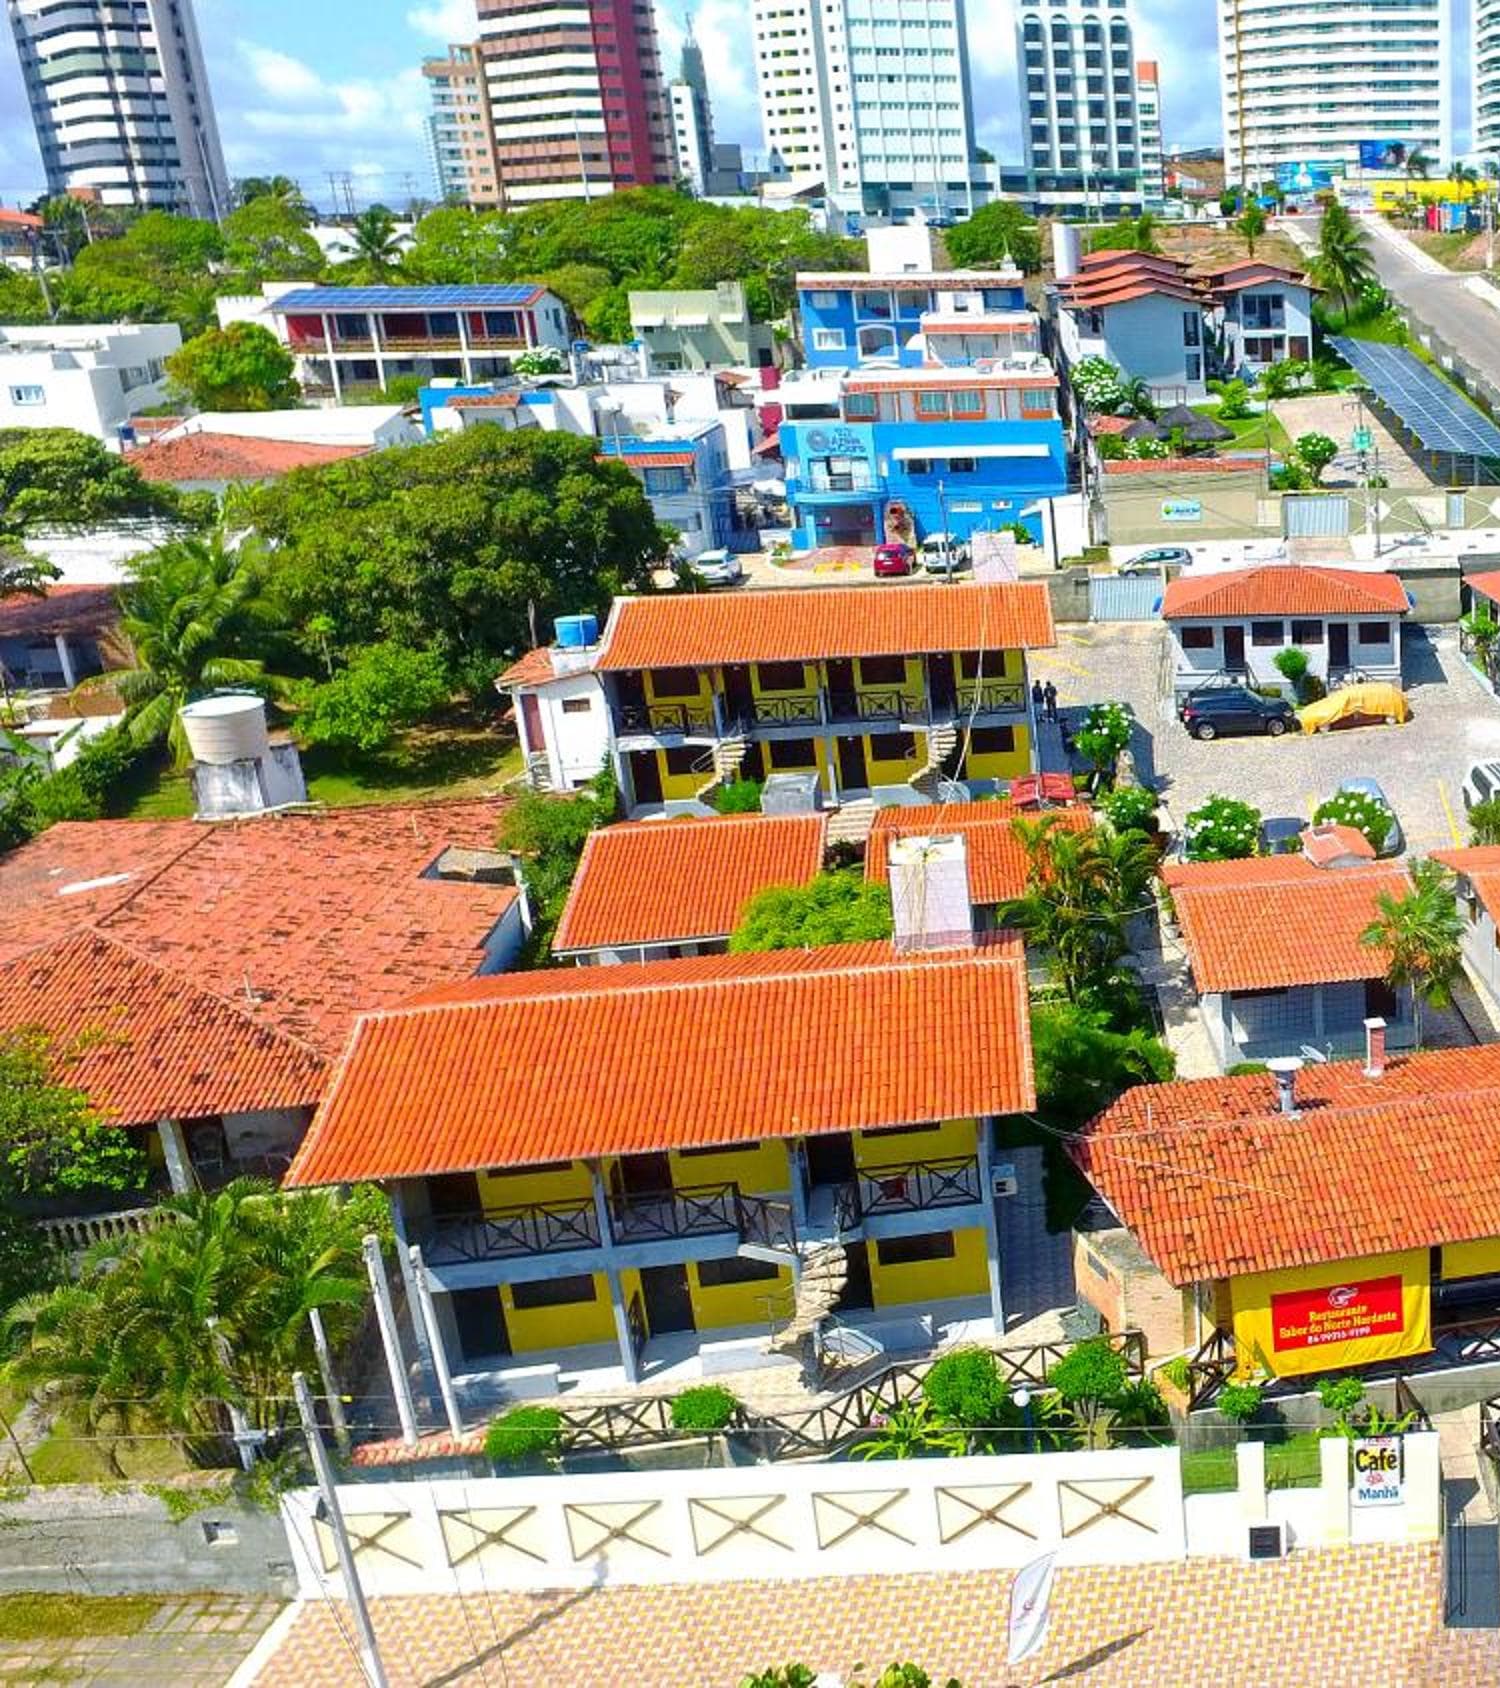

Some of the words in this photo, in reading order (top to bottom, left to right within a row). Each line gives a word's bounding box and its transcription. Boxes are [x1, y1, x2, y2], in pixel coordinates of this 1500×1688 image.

[1309, 1304, 1367, 1322] Restaurante
[1279, 1326, 1307, 1339] Sabor
[1324, 1319, 1351, 1332] Norte
[1353, 1312, 1397, 1327] Nordeste
[1355, 1447, 1398, 1472] Café
[1359, 1486, 1399, 1500] Manhã
